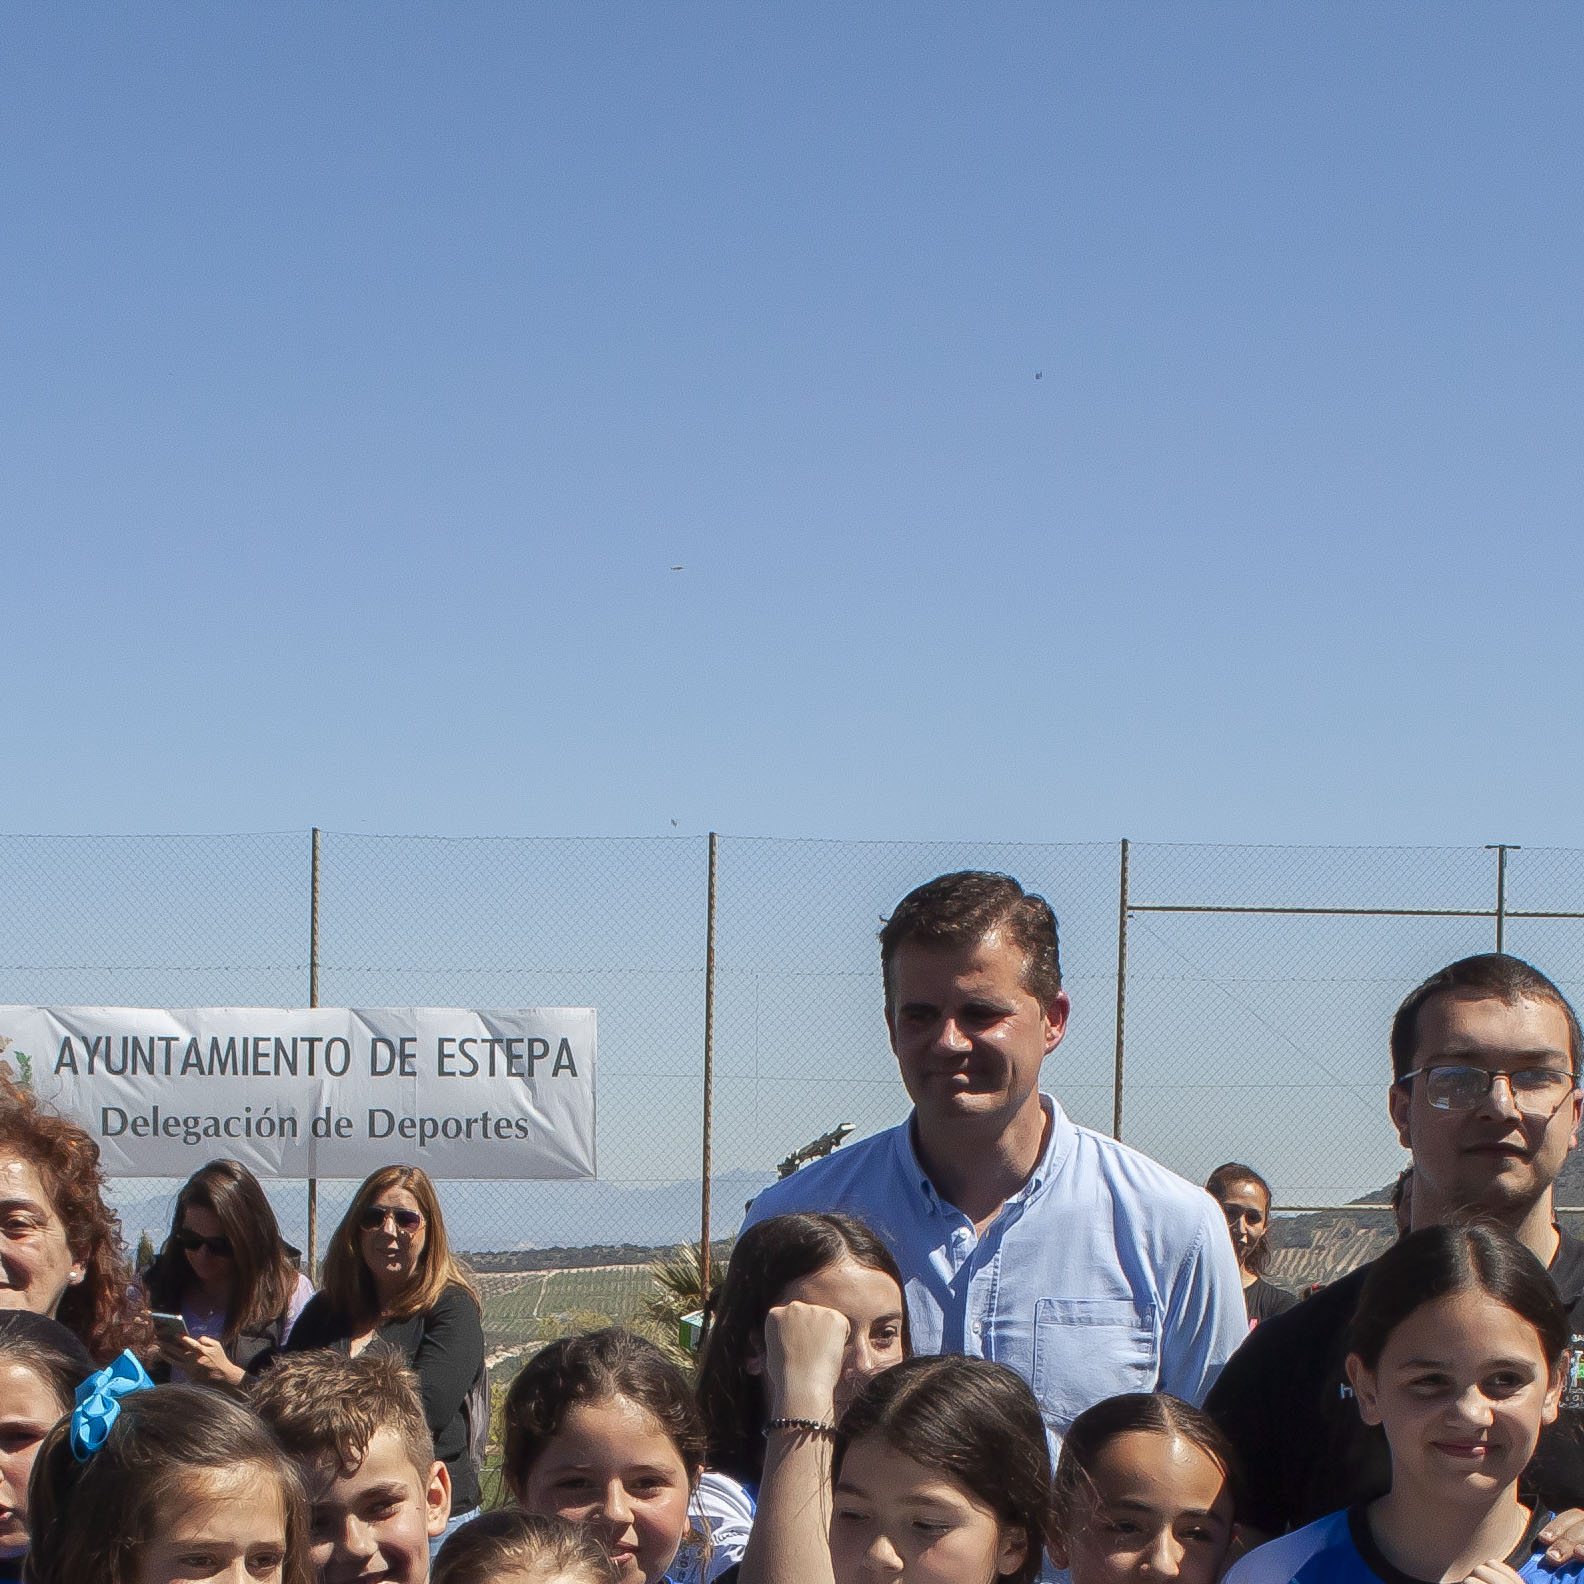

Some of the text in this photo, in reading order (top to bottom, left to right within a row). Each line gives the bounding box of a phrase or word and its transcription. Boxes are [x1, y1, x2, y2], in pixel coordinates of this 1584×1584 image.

[54, 1036, 579, 1078] AYUNTAMIENTO DE ESTEPA
[100, 1104, 529, 1147] Delegación de Deportes
